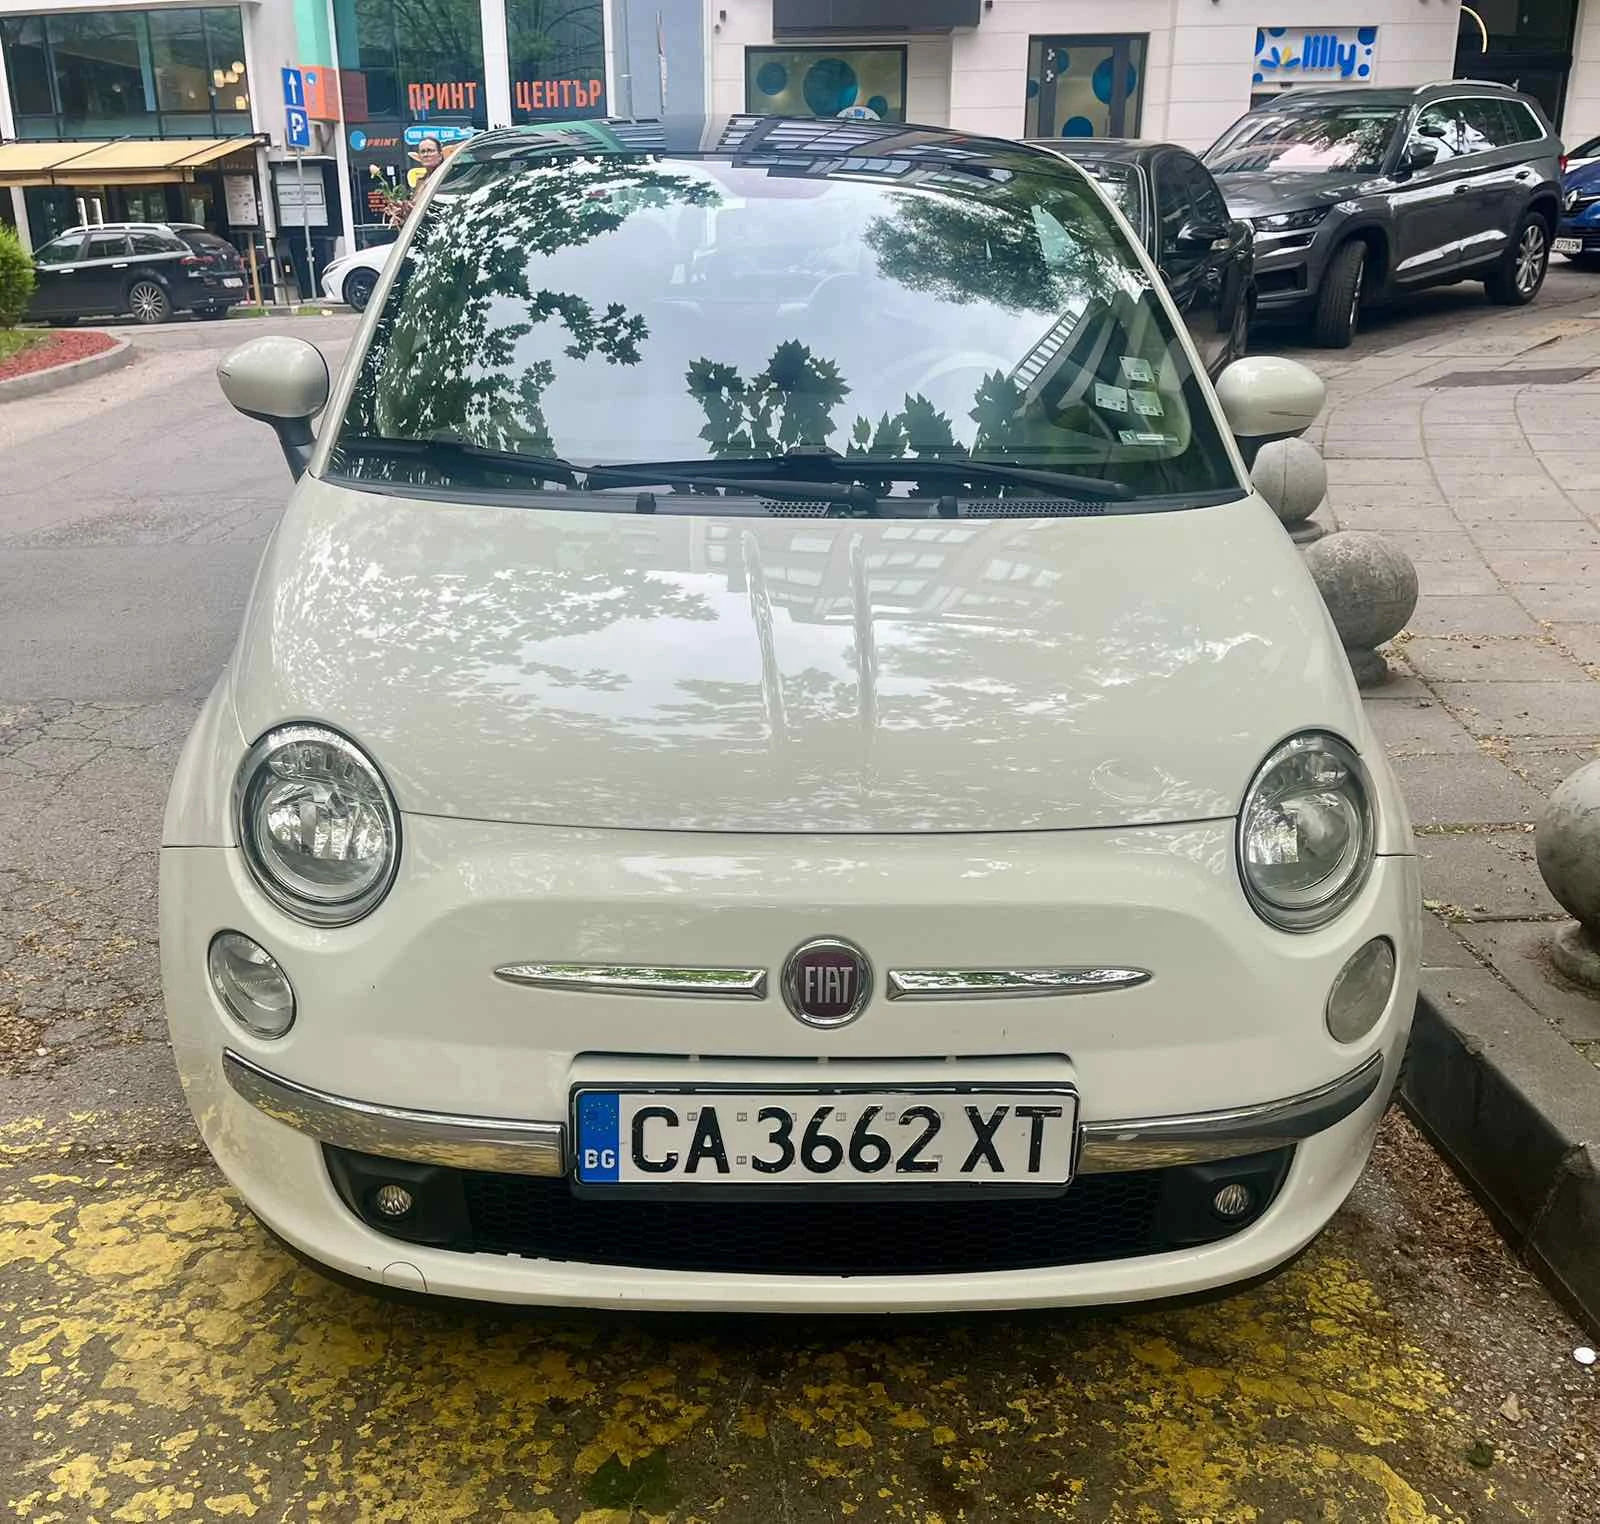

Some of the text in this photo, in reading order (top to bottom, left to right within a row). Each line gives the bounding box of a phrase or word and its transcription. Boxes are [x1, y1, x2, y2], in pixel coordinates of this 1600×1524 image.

[1302, 35, 1356, 77] lilly
[408, 79, 601, 111] ПРИНТ ЦЕНТЪР
[291, 112, 304, 142] P
[805, 966, 853, 1003] FIAT
[631, 1105, 1063, 1174] CA 3662 XT
[584, 1148, 616, 1169] BG
